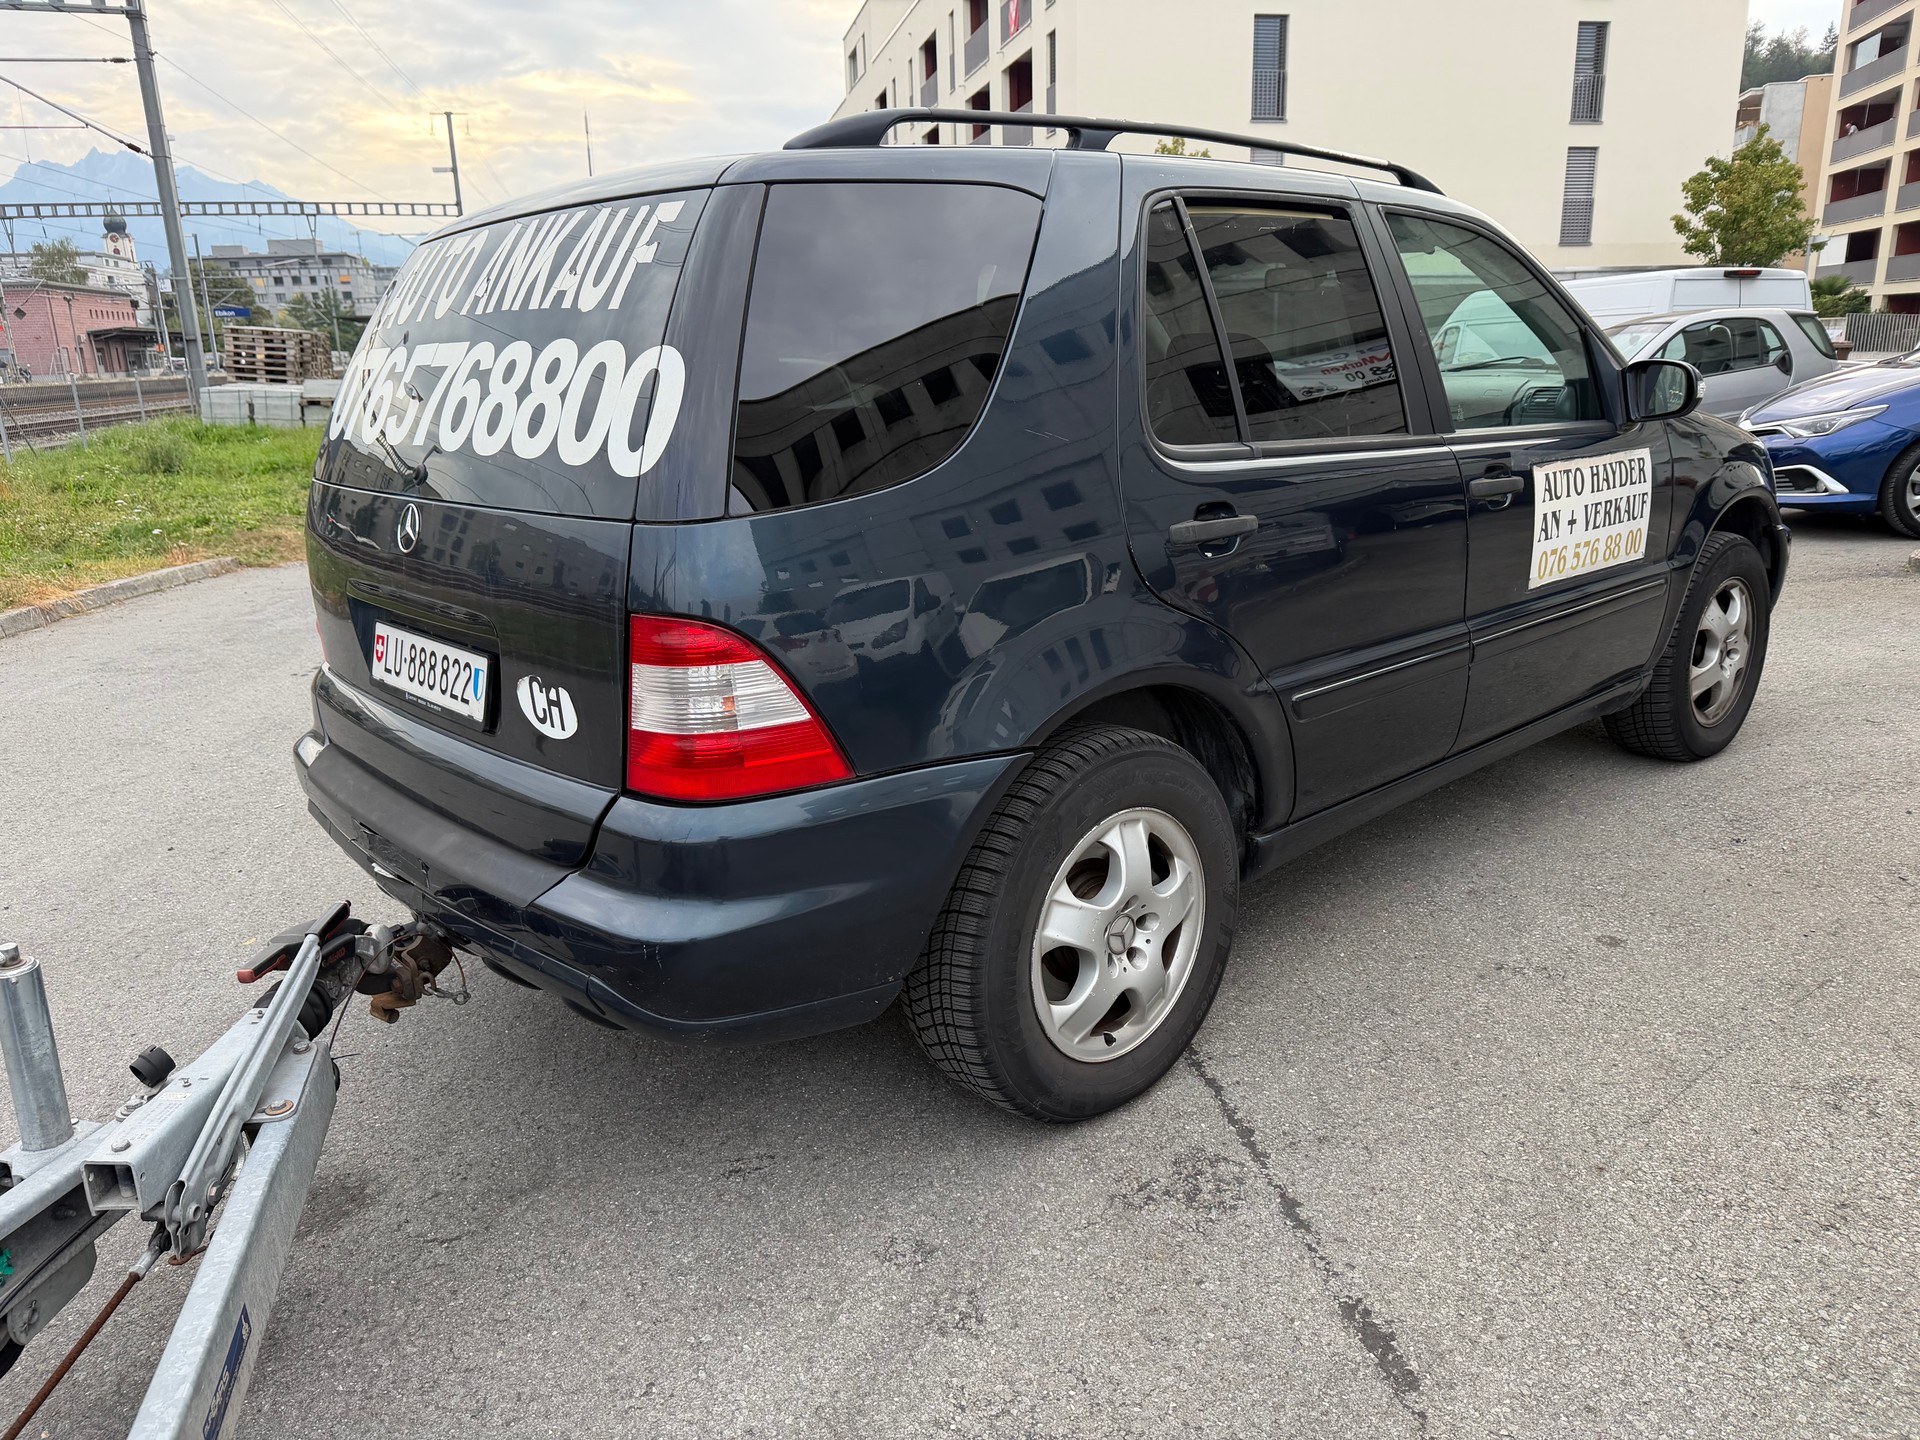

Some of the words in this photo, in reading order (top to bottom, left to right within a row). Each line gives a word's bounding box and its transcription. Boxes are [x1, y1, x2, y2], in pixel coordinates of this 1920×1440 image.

[376, 229, 490, 329] AUTO
[460, 200, 686, 316] ANKAUF
[329, 338, 686, 478] 0765768800
[1541, 467, 1585, 503] AUTO
[1589, 457, 1647, 494] HAYDER
[1537, 510, 1562, 543] AN
[1567, 509, 1577, 535] +
[1584, 492, 1649, 532] VERKAUF
[1537, 545, 1568, 580] 076
[1570, 538, 1601, 571] 576
[1603, 532, 1622, 563] 88
[1625, 527, 1642, 556] 00
[528, 675, 566, 732] CH
